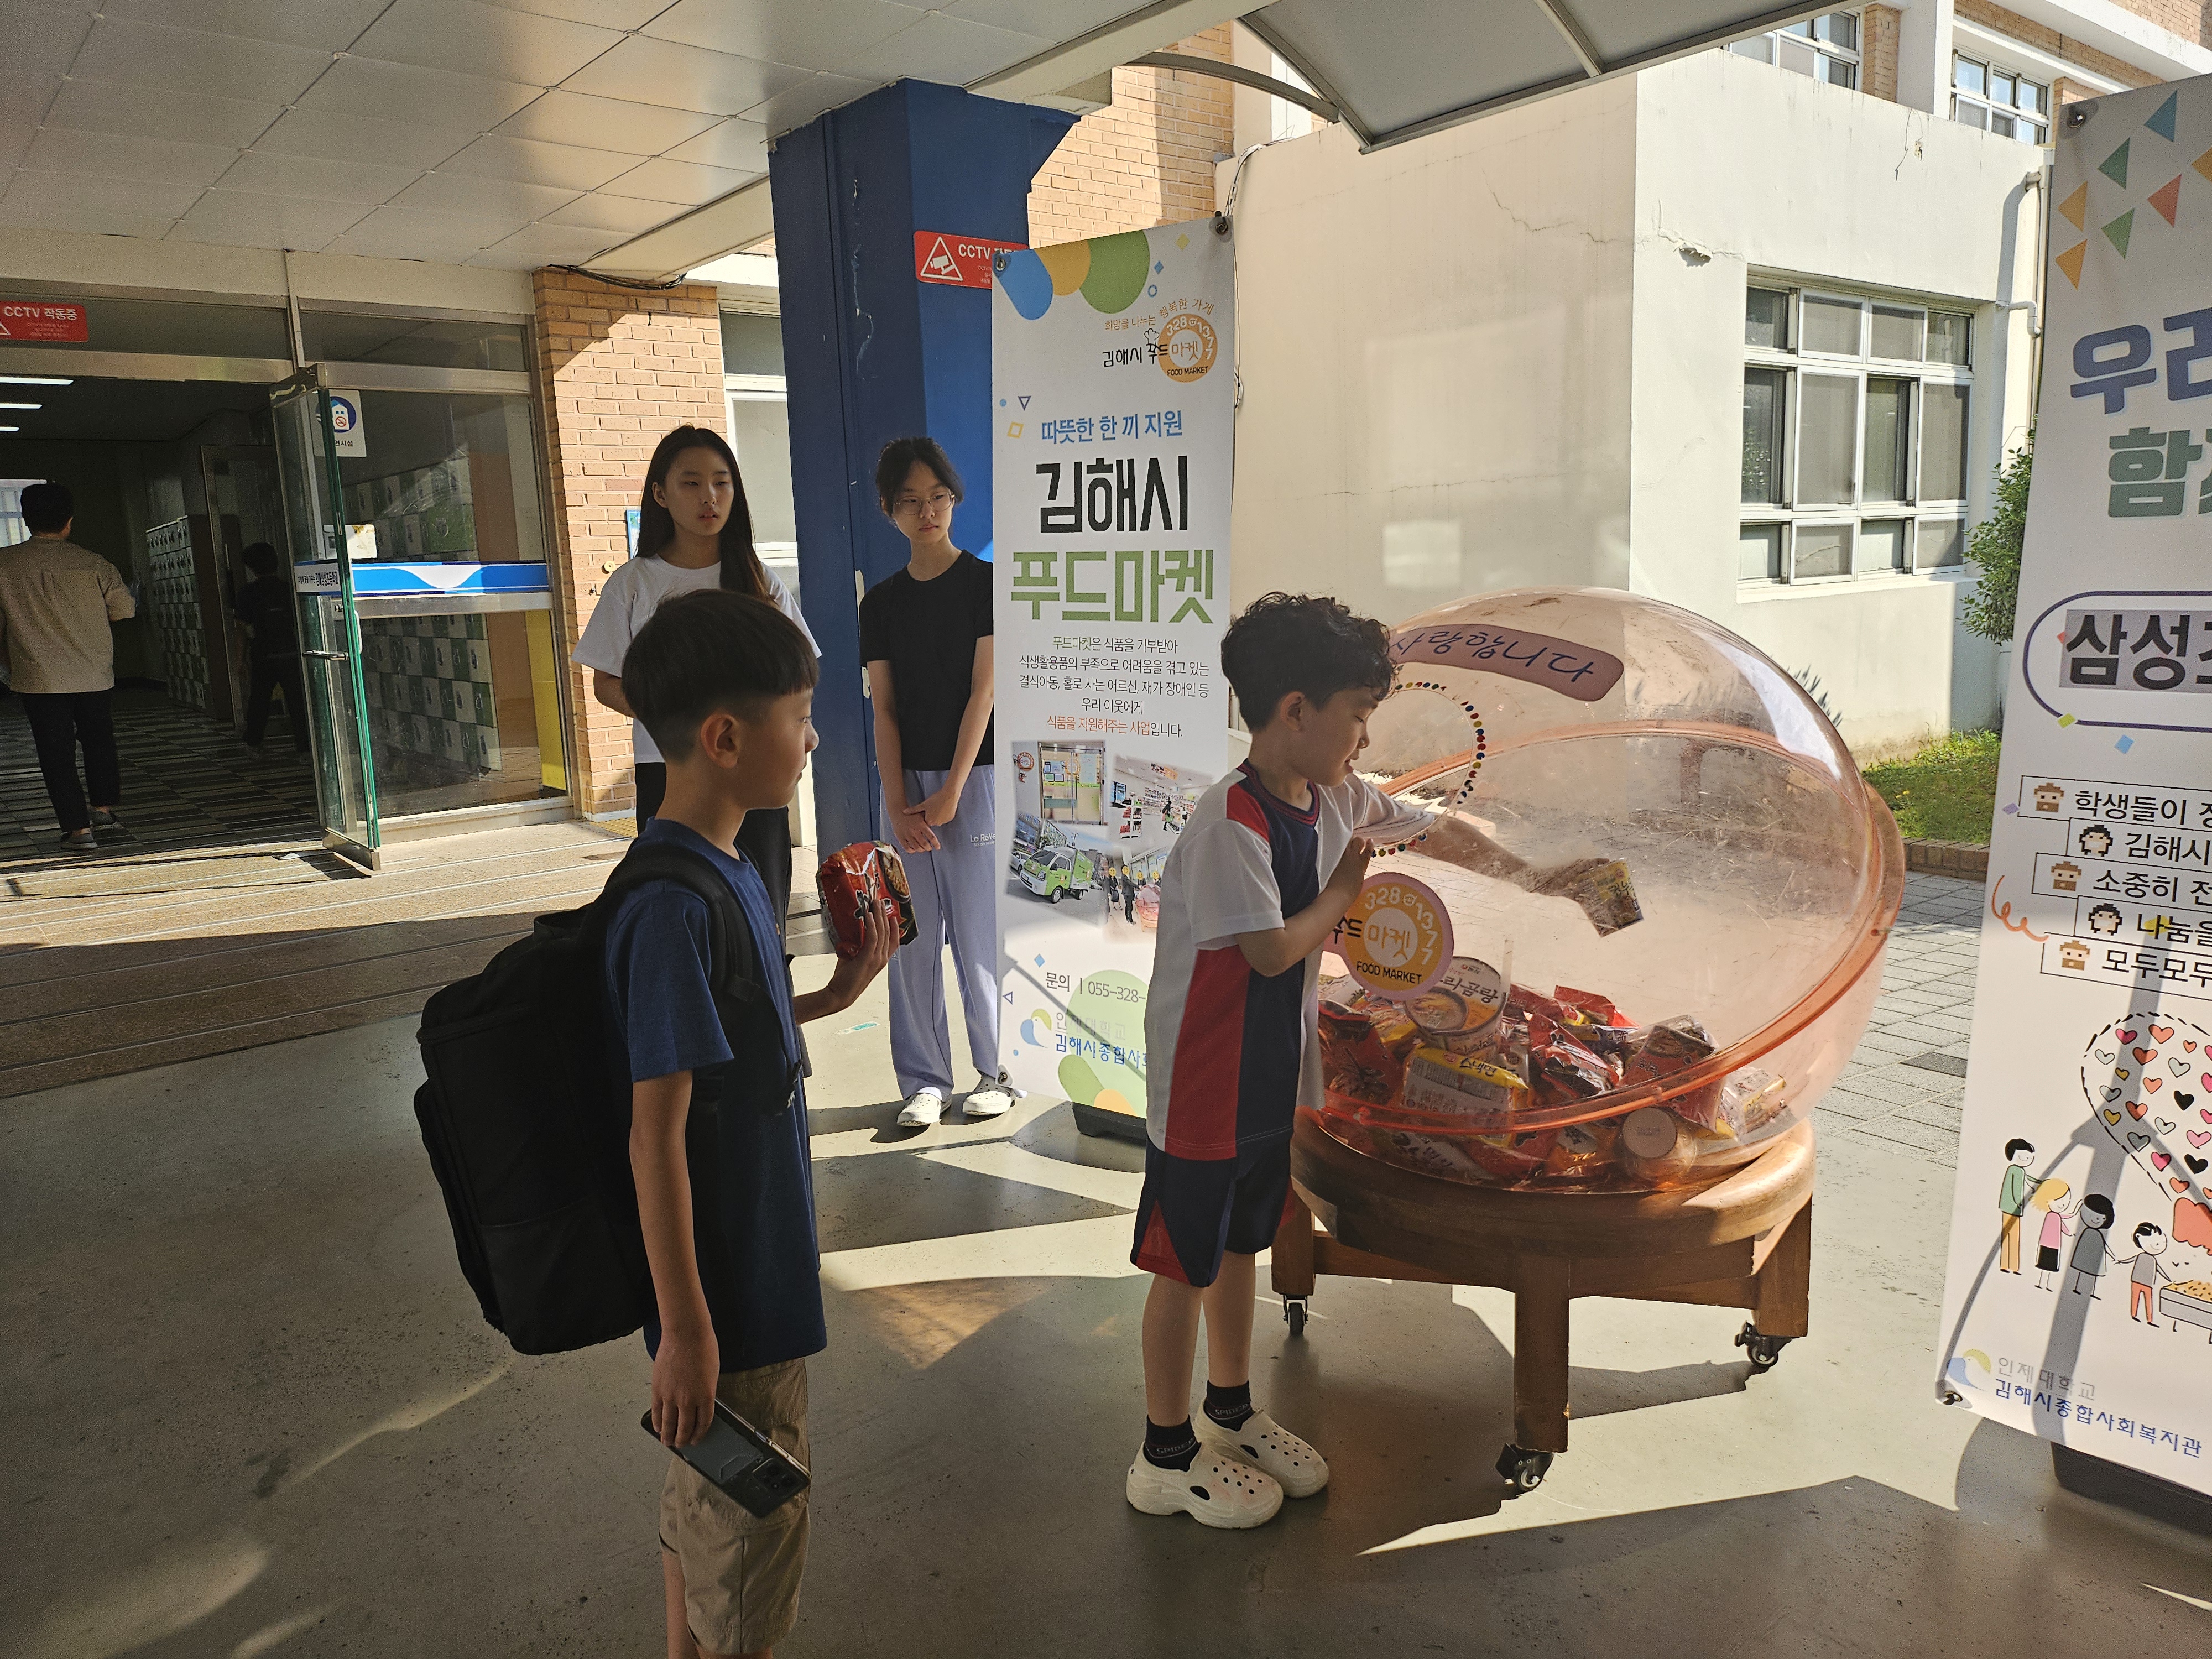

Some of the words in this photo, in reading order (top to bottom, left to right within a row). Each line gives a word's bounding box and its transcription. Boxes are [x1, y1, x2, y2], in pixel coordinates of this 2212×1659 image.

[958, 243, 990, 260] CCTV
[4, 306, 40, 318] CCTV
[44, 307, 78, 321] 작동중
[1105, 318, 1129, 331] 희망을
[1132, 315, 1156, 327] 나누는
[1160, 298, 1187, 318] 행복한
[1192, 299, 1214, 315] 가게
[1167, 316, 1187, 336] 328
[1197, 322, 1214, 359] 1377
[1102, 347, 1142, 368] 김해시
[1167, 368, 1183, 377] FOOD
[1184, 366, 1209, 375] MARKET
[1041, 416, 1094, 444] 따뜻한
[1099, 415, 1117, 441] 한
[1123, 413, 1139, 439] 끼
[1145, 410, 1183, 437] 지원
[2108, 427, 2212, 518] 함
[1036, 456, 1188, 534] 김해시
[1011, 550, 1214, 624] 푸드마켓
[1052, 636, 1102, 651] 푸드마켓은
[1104, 637, 1134, 653] 식품을
[1138, 639, 1178, 654] 기부받아
[1389, 631, 1594, 682] 사랑합니다
[1019, 655, 1078, 671] 식생활용품의
[1079, 657, 1120, 672] 부족으로
[1123, 659, 1162, 674] 어려움을
[1166, 660, 1186, 675] 겪고
[1189, 661, 1209, 676] 있는
[1019, 675, 1060, 690] 결식아동,
[1062, 676, 1083, 690] 홀로
[1085, 677, 1105, 692] 사는
[1107, 679, 1139, 694] 어르신,
[1141, 681, 1163, 696] 재가
[1165, 681, 1196, 697] 장애인
[1198, 683, 1209, 698] 등
[1081, 697, 1101, 712] 우리
[1104, 698, 1144, 714] 이웃에게
[1047, 716, 1076, 731] 식품을
[1078, 717, 1128, 734] 지원해주는
[1129, 721, 1182, 738] 사업입니다.
[2075, 790, 2187, 826] 학생들이
[2125, 832, 2211, 866] 김해시
[2093, 869, 2178, 902] 소중히
[1364, 886, 1401, 910] 328
[1415, 902, 1438, 966] 1377
[1045, 972, 1070, 992] 문의
[1356, 961, 1381, 977] FOOD
[1383, 966, 1422, 985] MARKET
[2102, 949, 2212, 988] 모두모두
[1440, 975, 1499, 1004] 리곰탕
[1459, 1057, 1498, 1077] 스낵면
[1997, 1357, 2096, 1401] 인제대학교
[1995, 1378, 2203, 1458] 김해시종합사회복지관
